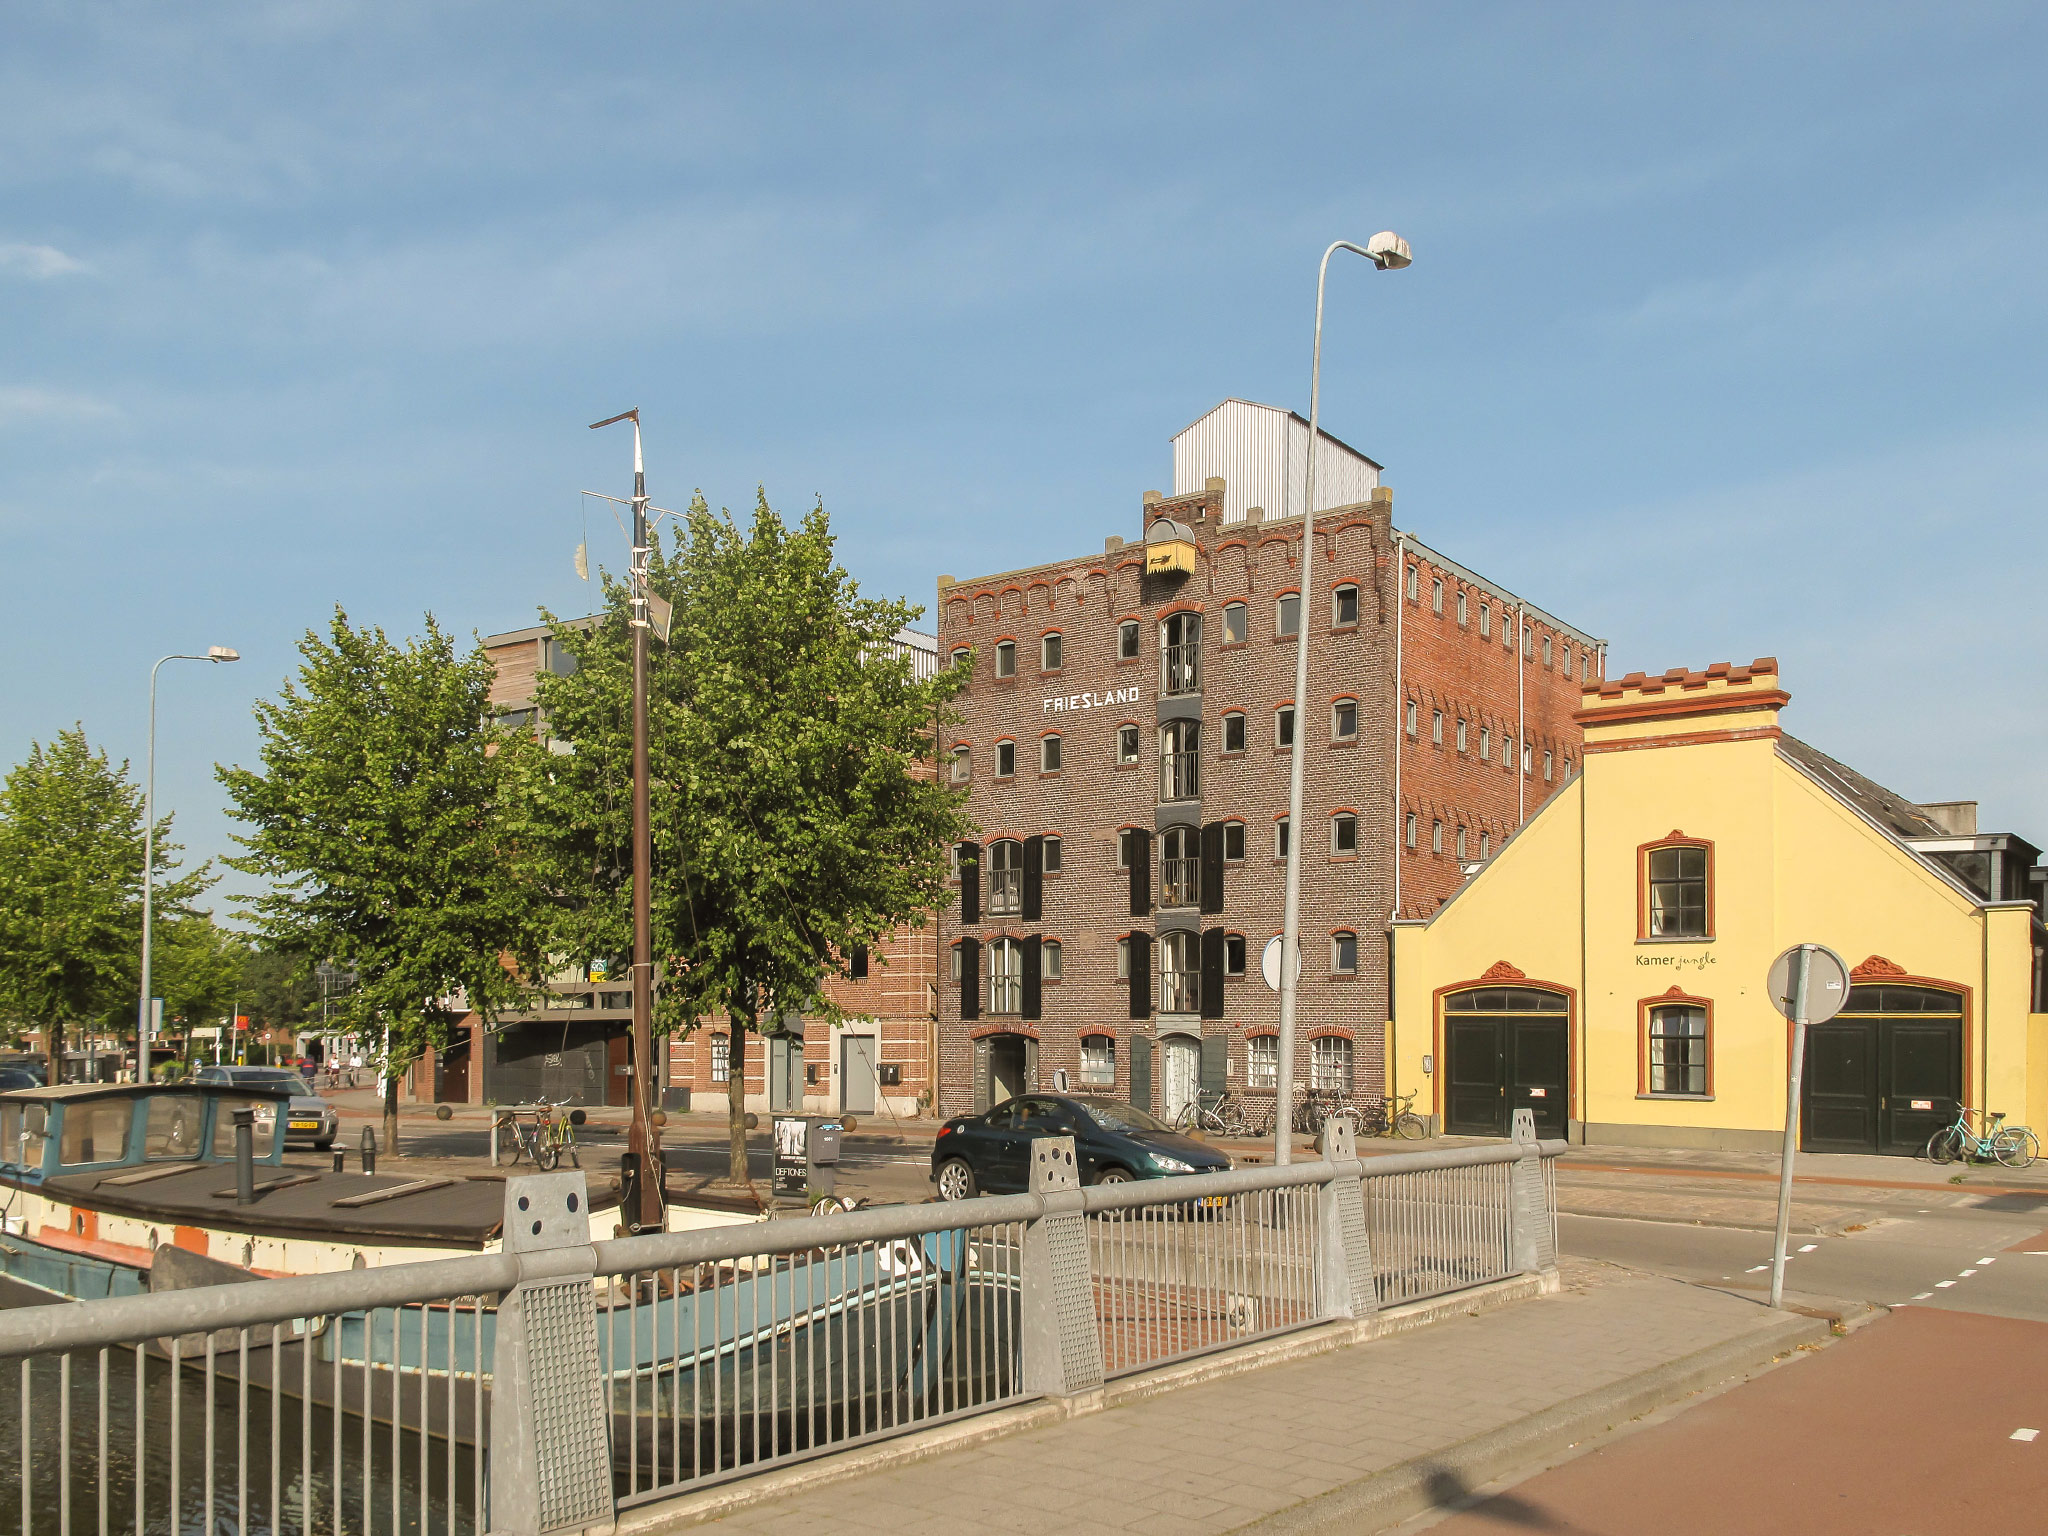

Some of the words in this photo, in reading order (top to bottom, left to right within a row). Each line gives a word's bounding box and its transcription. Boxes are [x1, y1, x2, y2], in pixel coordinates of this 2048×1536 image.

[1043, 687, 1139, 713] FRIESLAND
[1636, 955, 1675, 966] Kamer
[1675, 951, 1717, 971] jungle
[775, 1168, 807, 1177] DEFTONES
